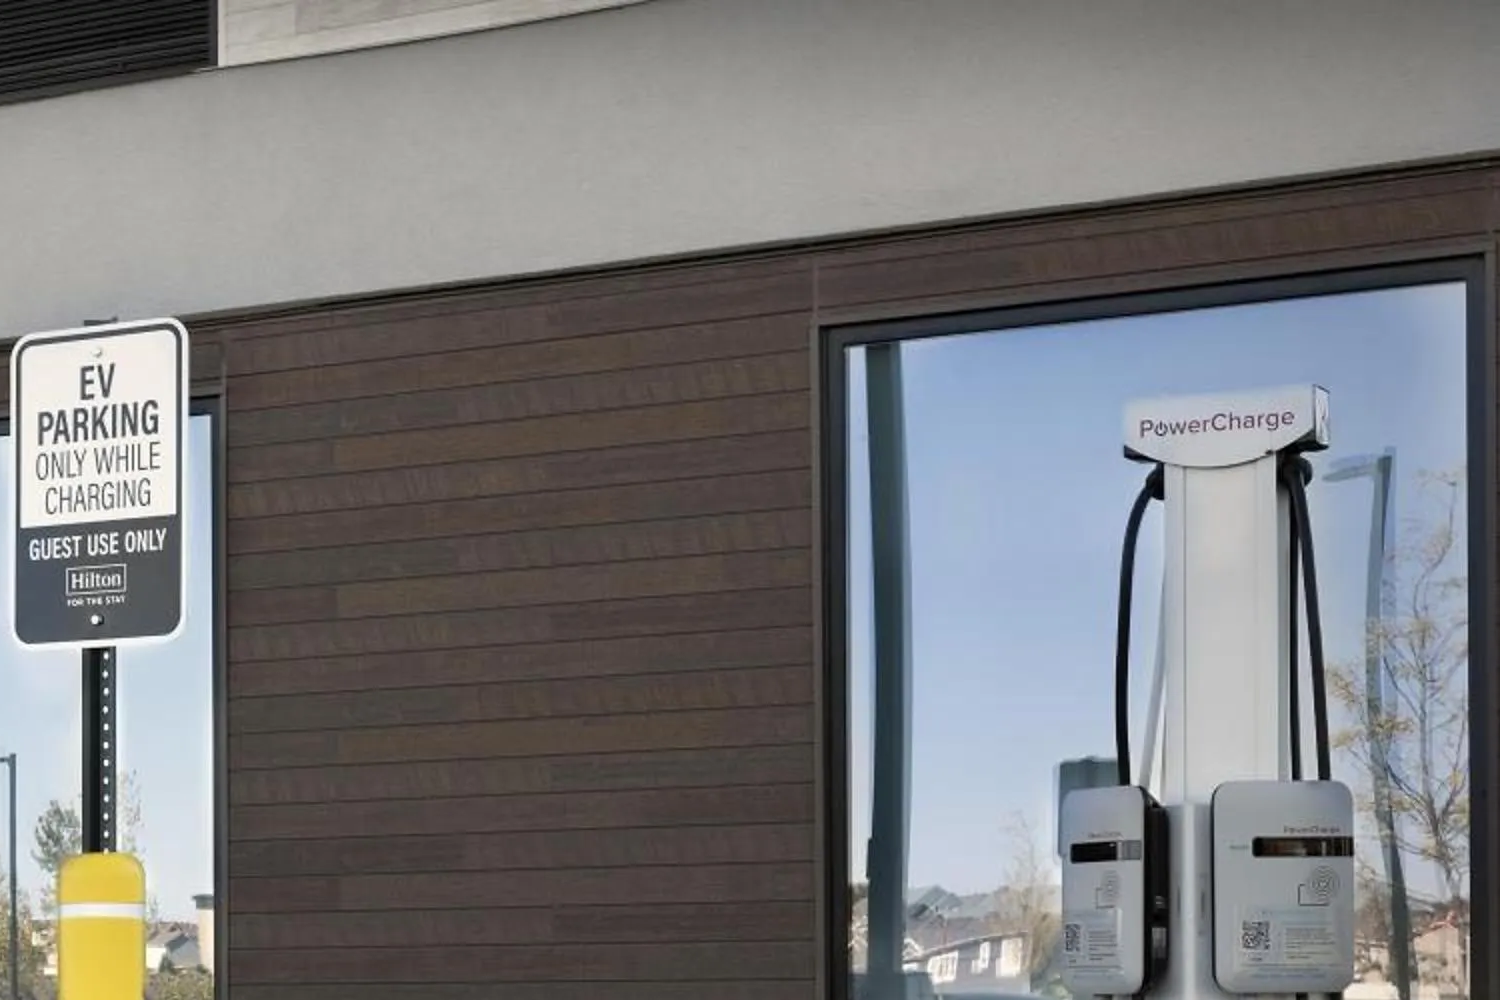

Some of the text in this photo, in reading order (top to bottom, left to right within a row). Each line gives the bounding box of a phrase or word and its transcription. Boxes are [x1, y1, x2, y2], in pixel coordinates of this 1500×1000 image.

[79, 362, 116, 401] EV
[36, 399, 160, 446] PARKING
[1139, 410, 1296, 439] PowerCharge
[35, 441, 161, 481] ONLY WHILE
[44, 476, 152, 515] CHARGING
[29, 527, 168, 561] GUEST USE ONLY
[71, 571, 122, 590] Hilton
